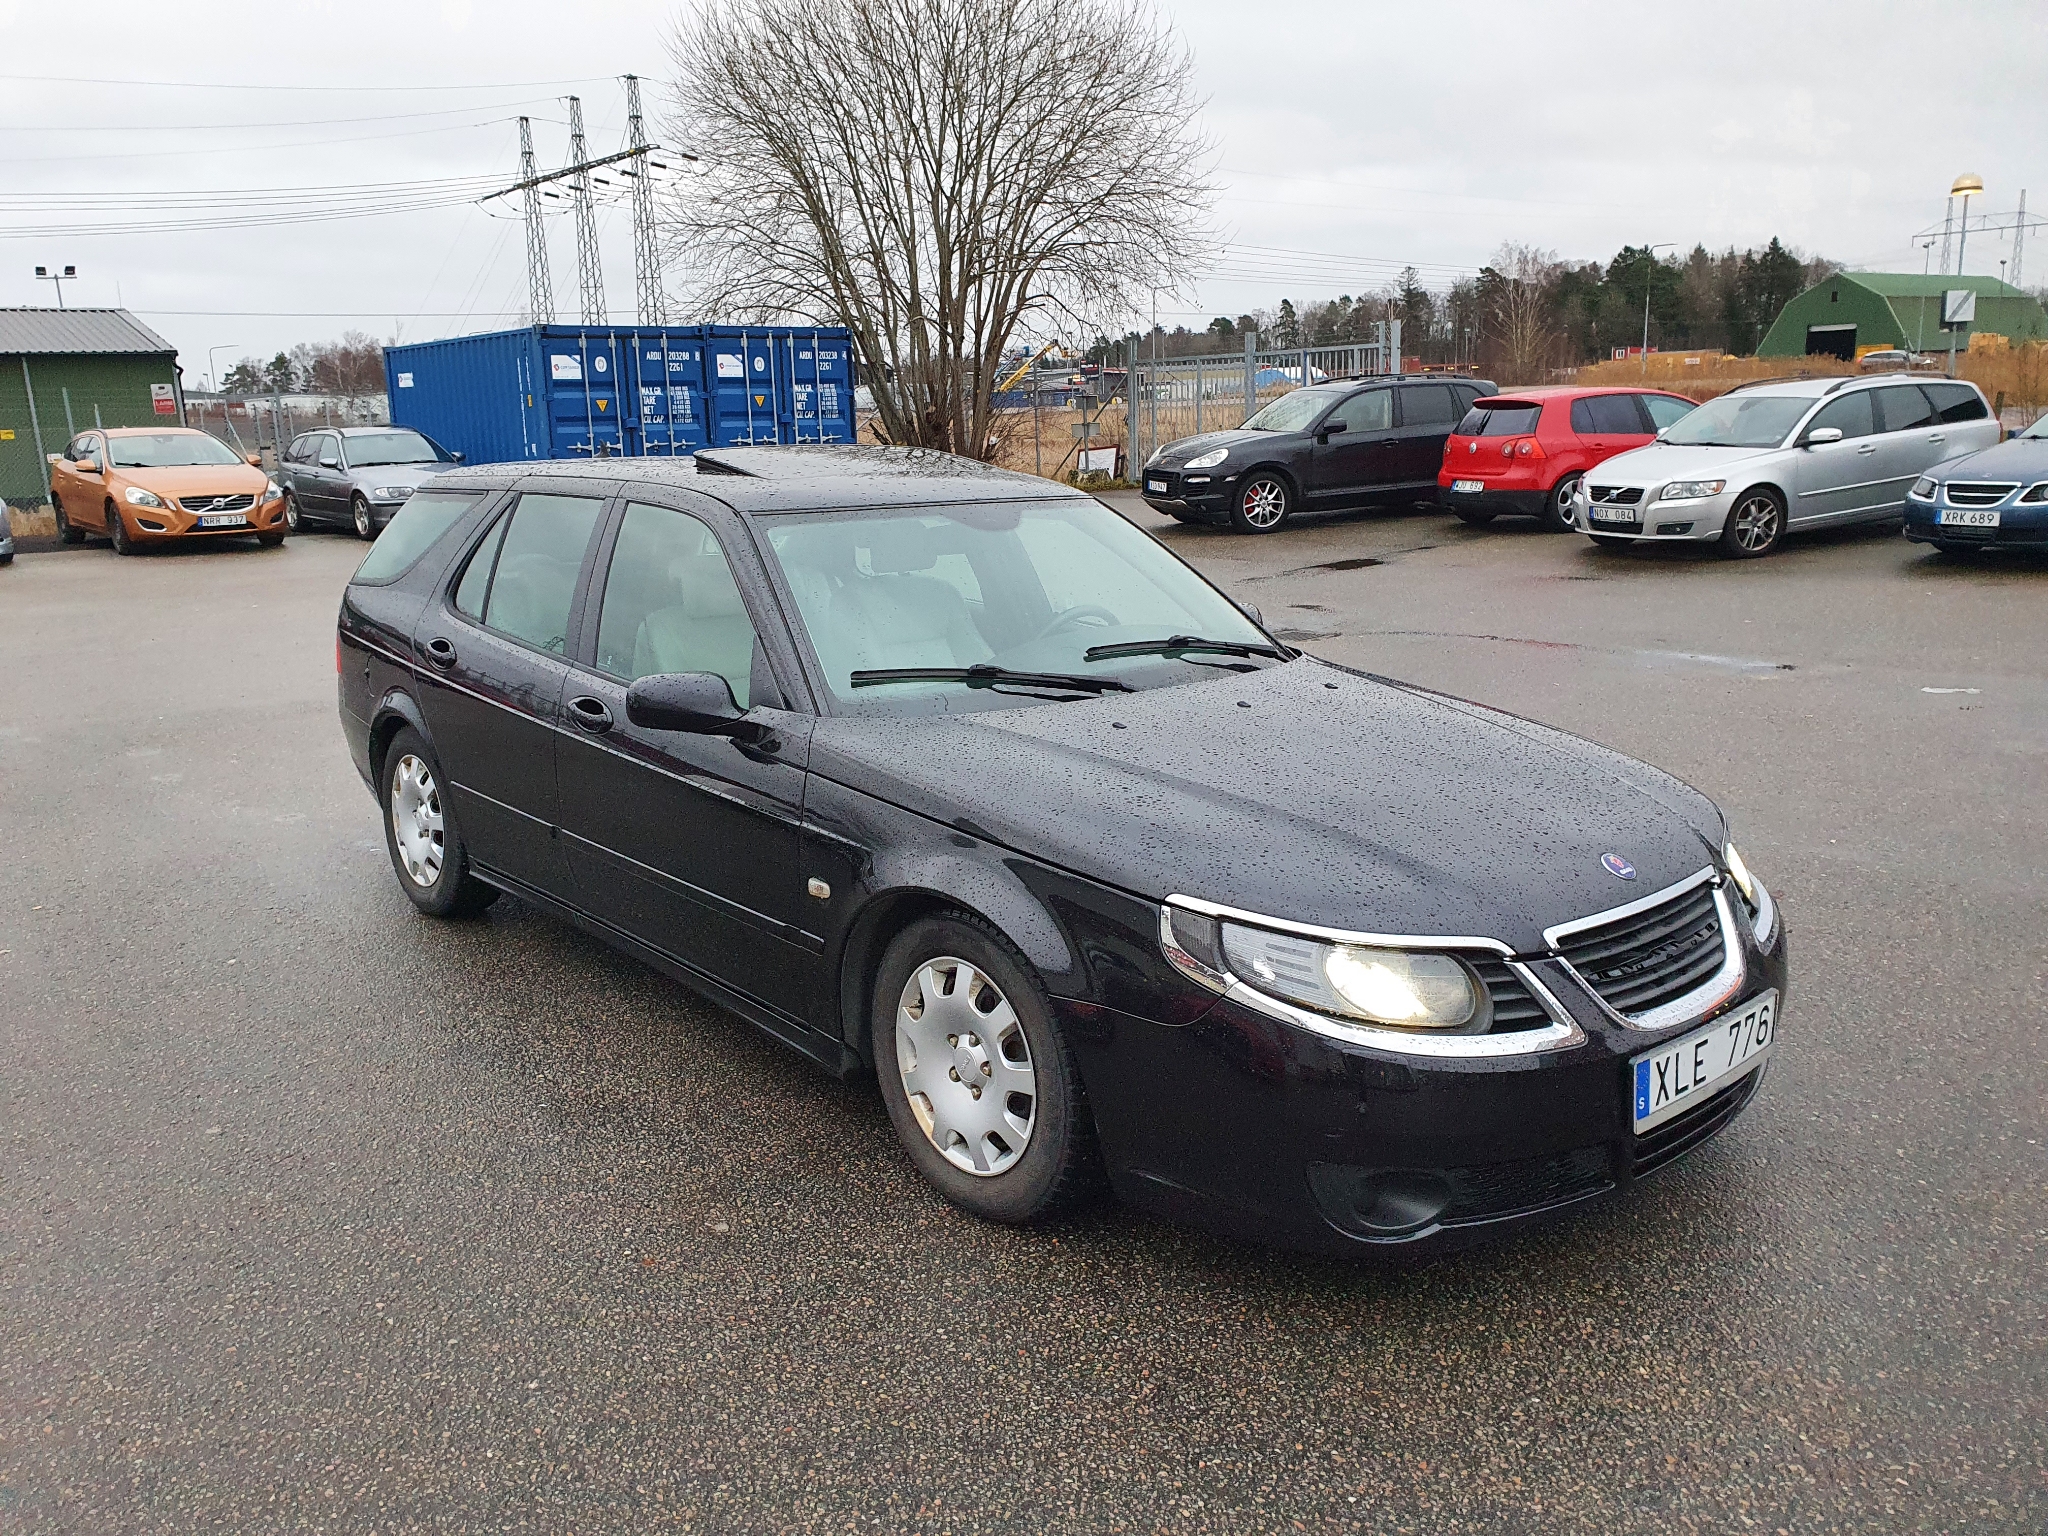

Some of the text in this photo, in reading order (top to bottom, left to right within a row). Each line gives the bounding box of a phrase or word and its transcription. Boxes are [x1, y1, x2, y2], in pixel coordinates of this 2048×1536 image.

[646, 351, 661, 360] ARDU
[668, 351, 689, 360] 203288
[799, 351, 812, 360] ARDU
[669, 363, 683, 371] 22G1
[820, 362, 831, 370] 22G1
[643, 396, 656, 404] TARE
[796, 393, 808, 401] TARE
[644, 406, 654, 414] NET
[796, 402, 805, 410] NET
[1470, 481, 1482, 490] 692
[1594, 509, 1632, 520] NOX 084
[1945, 511, 1994, 524] XRK 689
[203, 515, 244, 525] NRR 937
[1655, 1004, 1771, 1107] XLE 776
[1638, 1097, 1645, 1110] S
